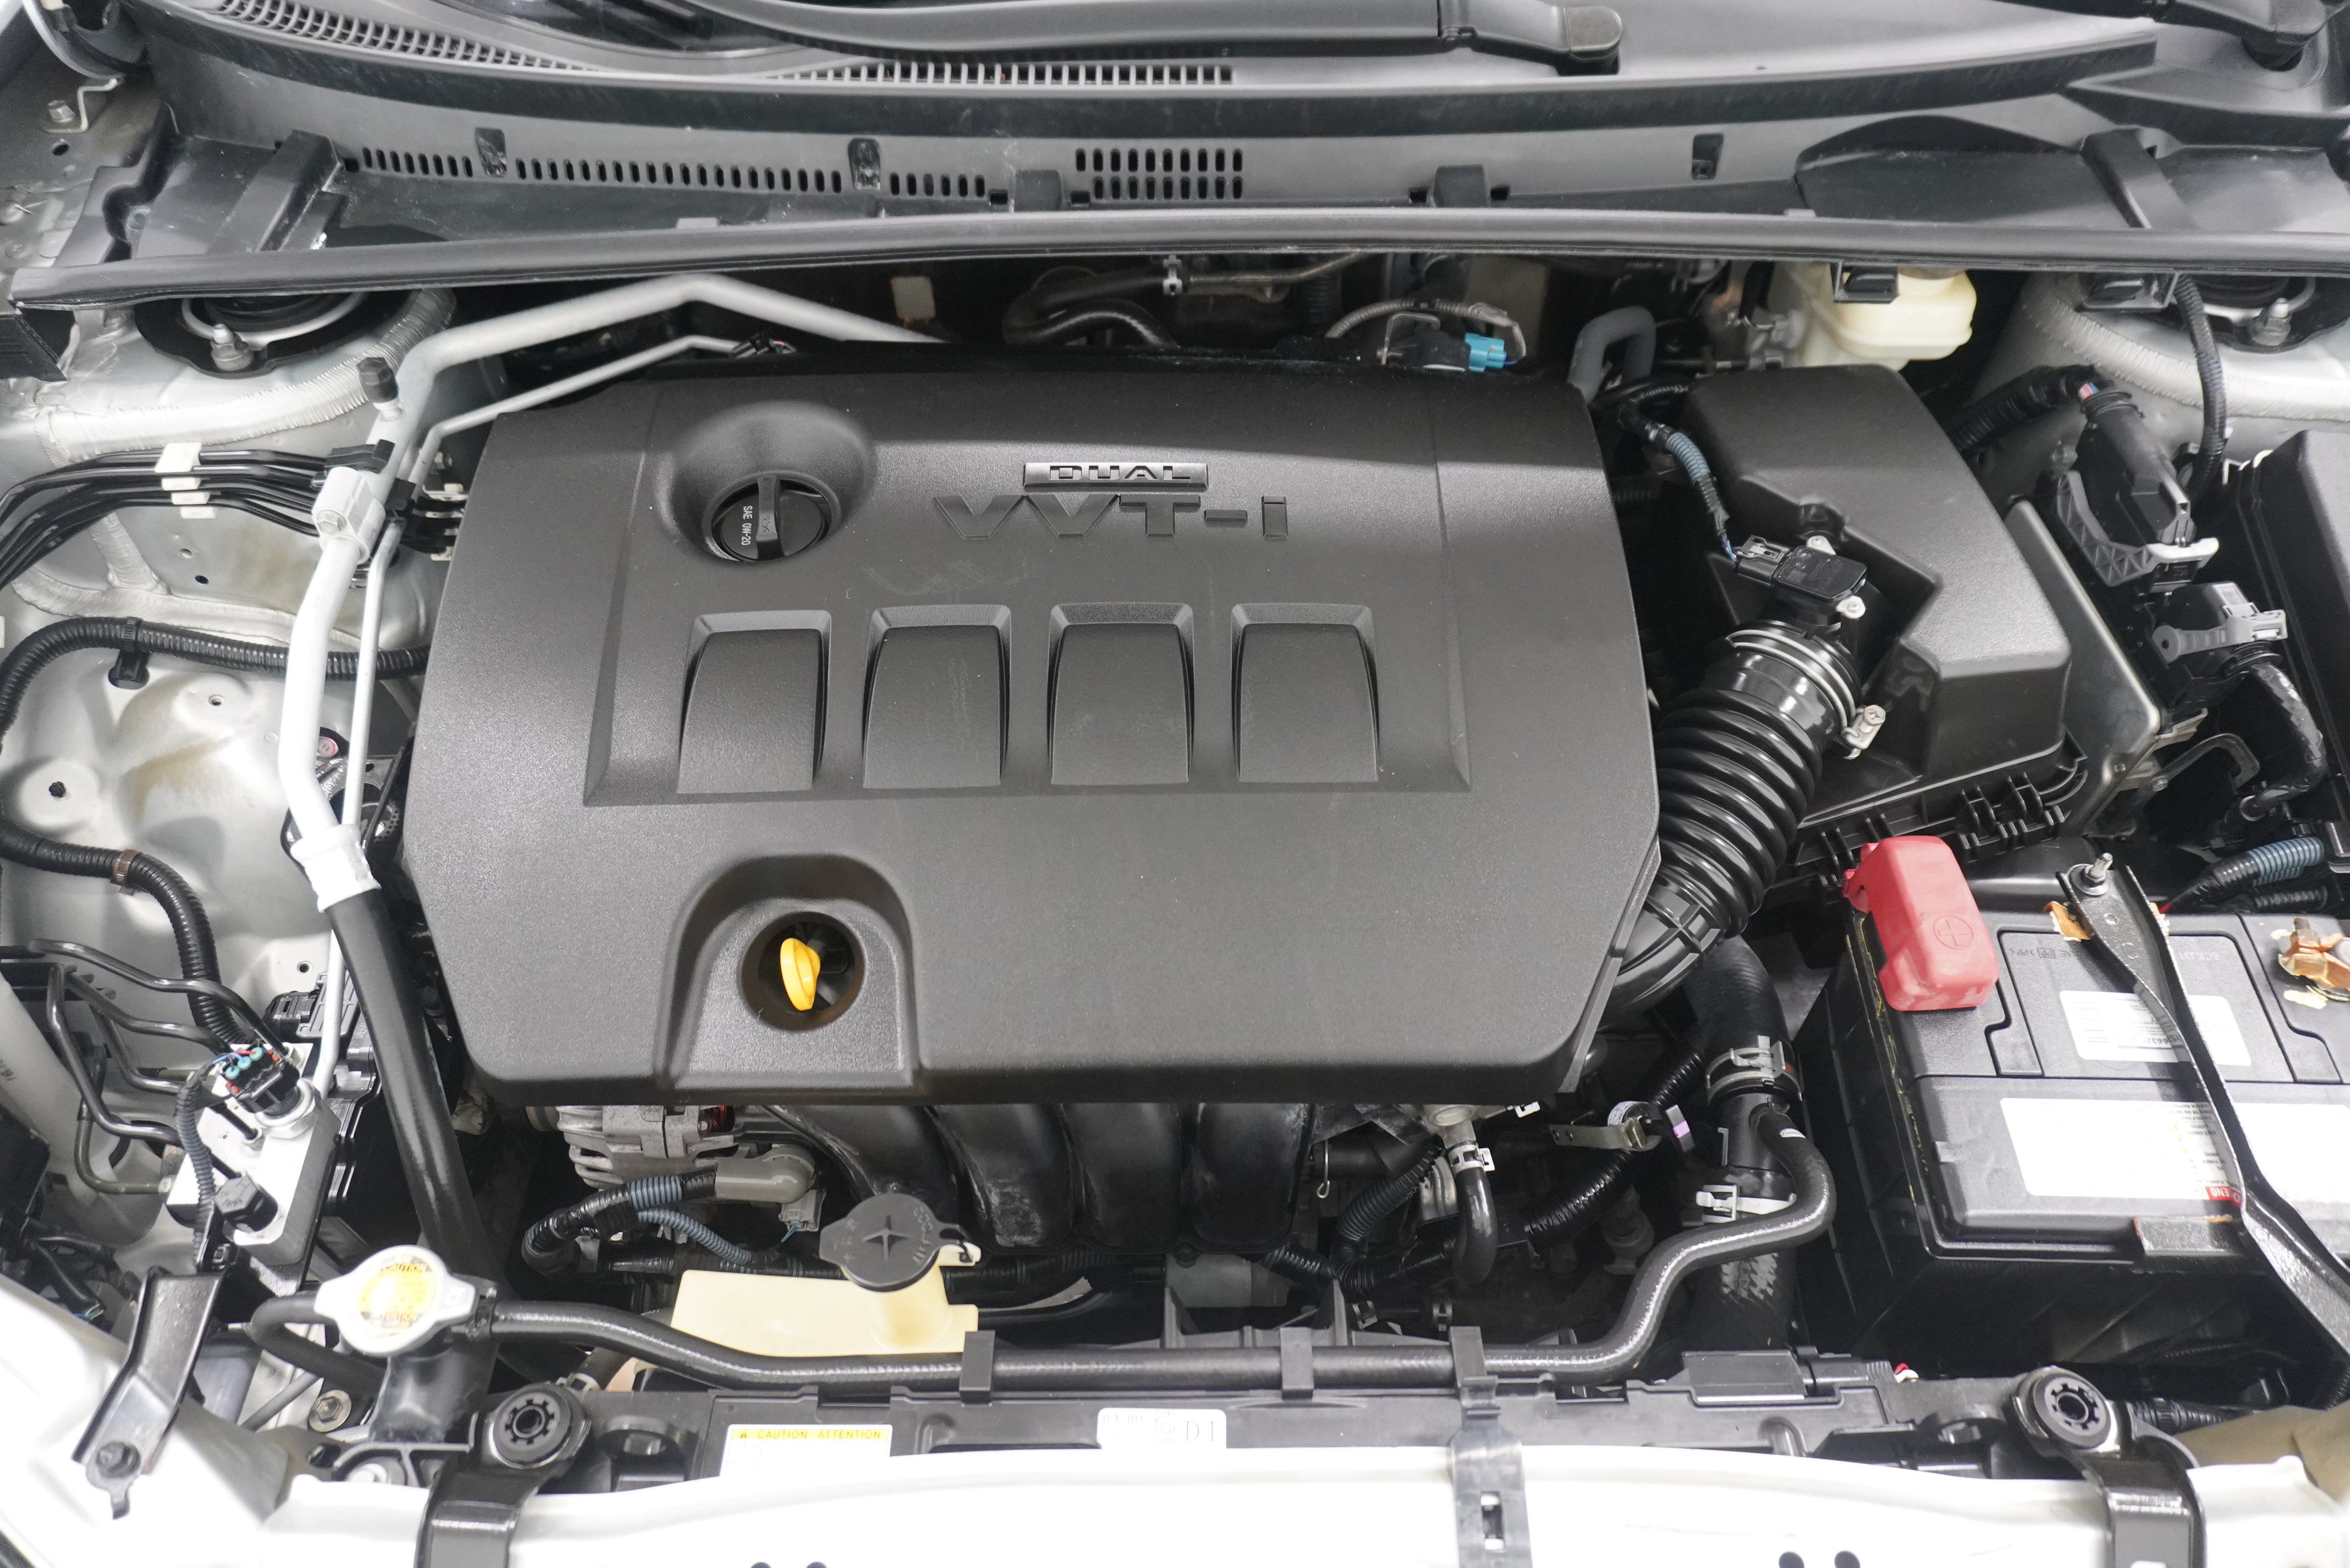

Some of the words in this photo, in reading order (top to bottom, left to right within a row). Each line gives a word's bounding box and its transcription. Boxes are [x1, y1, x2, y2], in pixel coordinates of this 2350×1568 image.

[1049, 465, 1191, 480] DUAL
[743, 506, 753, 519] SAE
[741, 523, 752, 545] 0W-20
[758, 1431, 807, 1439] CAUTION
[818, 1431, 881, 1439] ATTENTION
